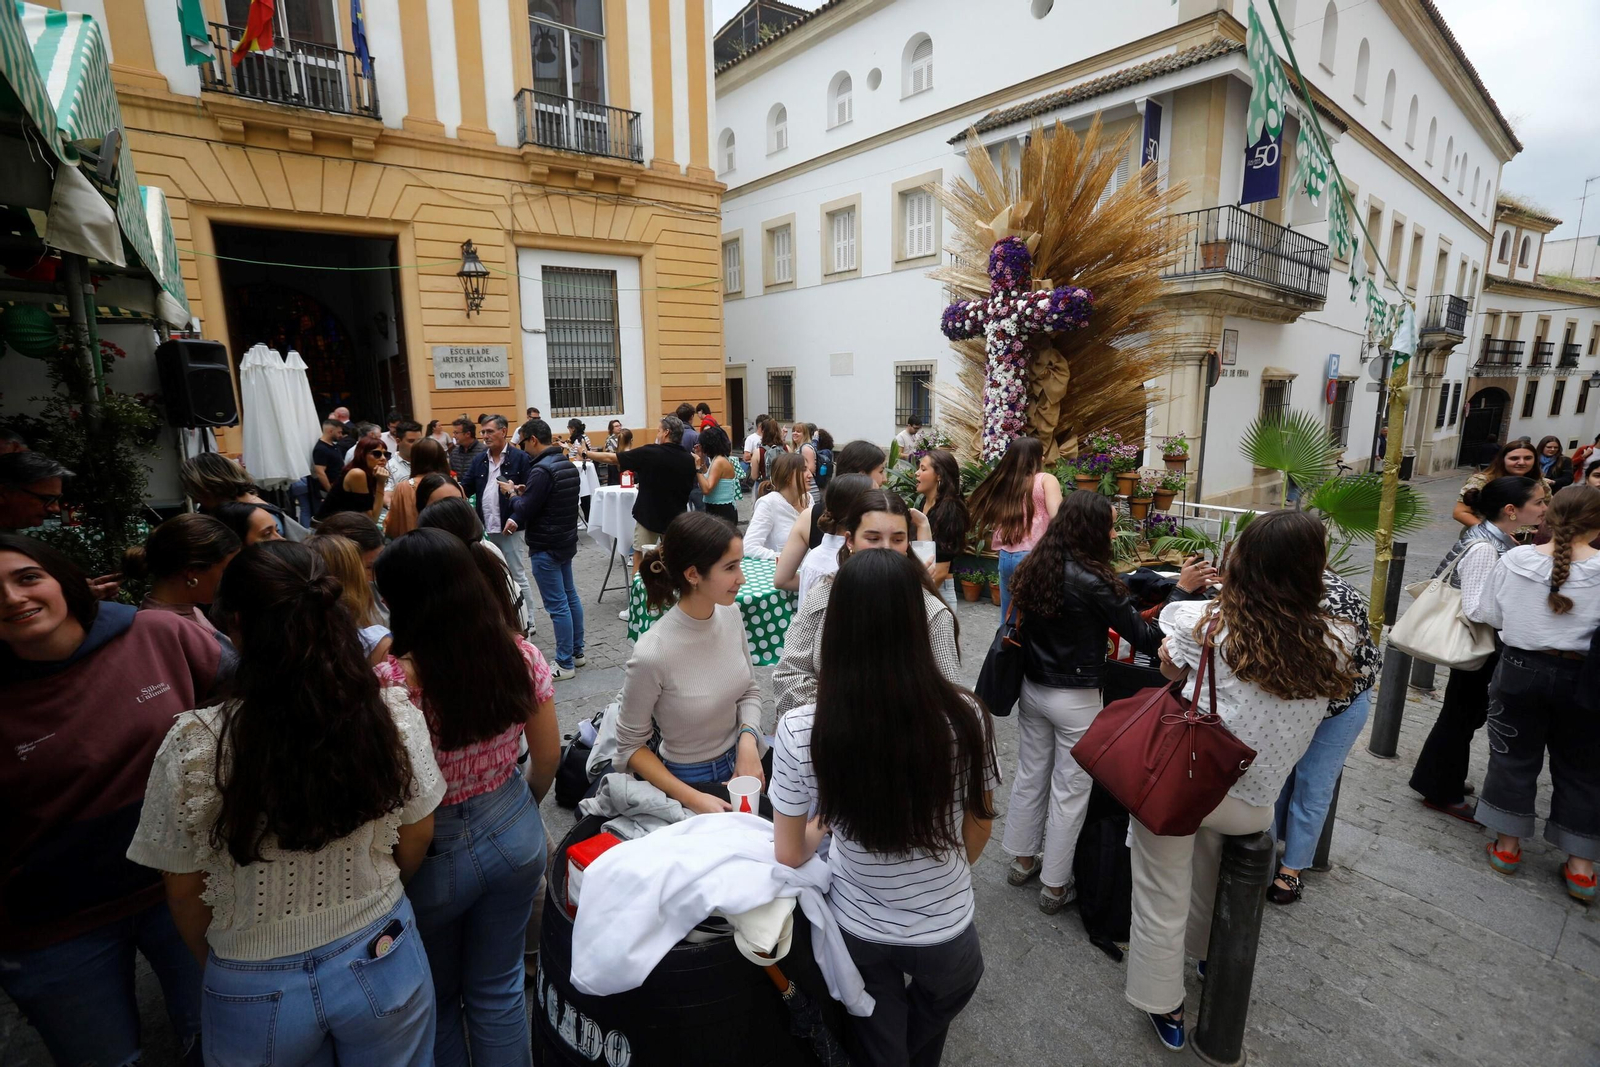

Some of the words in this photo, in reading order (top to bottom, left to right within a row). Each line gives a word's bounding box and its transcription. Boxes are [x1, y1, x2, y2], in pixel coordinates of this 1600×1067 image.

[1252, 143, 1279, 169] 50
[1331, 356, 1338, 375] P
[136, 684, 171, 703] Unlimited
